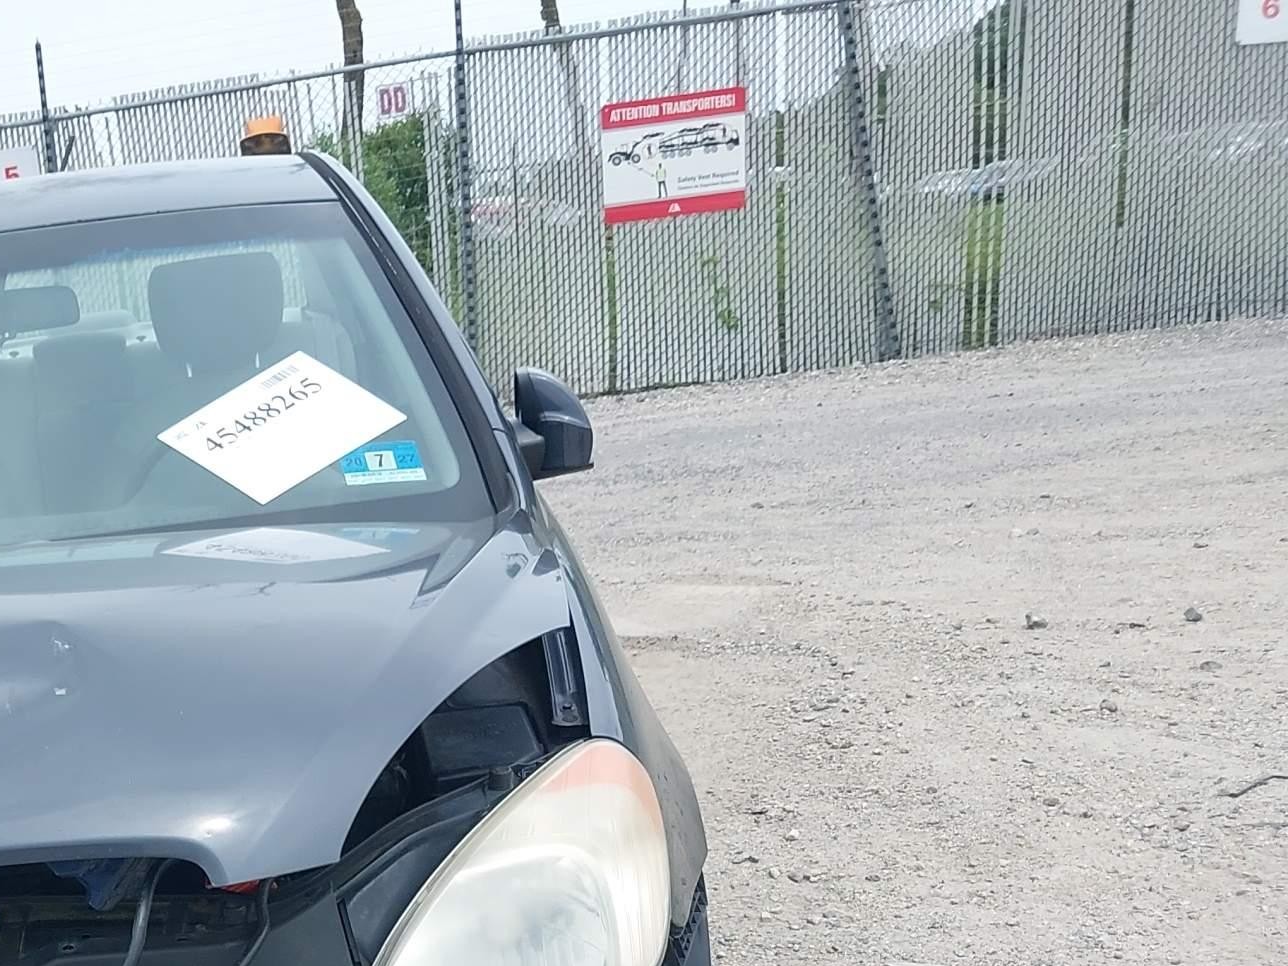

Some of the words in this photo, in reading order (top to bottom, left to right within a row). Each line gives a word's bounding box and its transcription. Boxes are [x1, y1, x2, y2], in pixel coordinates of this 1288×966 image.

[1263, 0, 1279, 19] 6
[609, 104, 659, 122] ATTENTION
[661, 94, 736, 115] TRANSPORTERS!
[5, 166, 19, 179] 5
[206, 377, 322, 451] 45488265
[345, 457, 363, 467] 20
[373, 453, 384, 468] 7
[397, 454, 415, 464] 27
